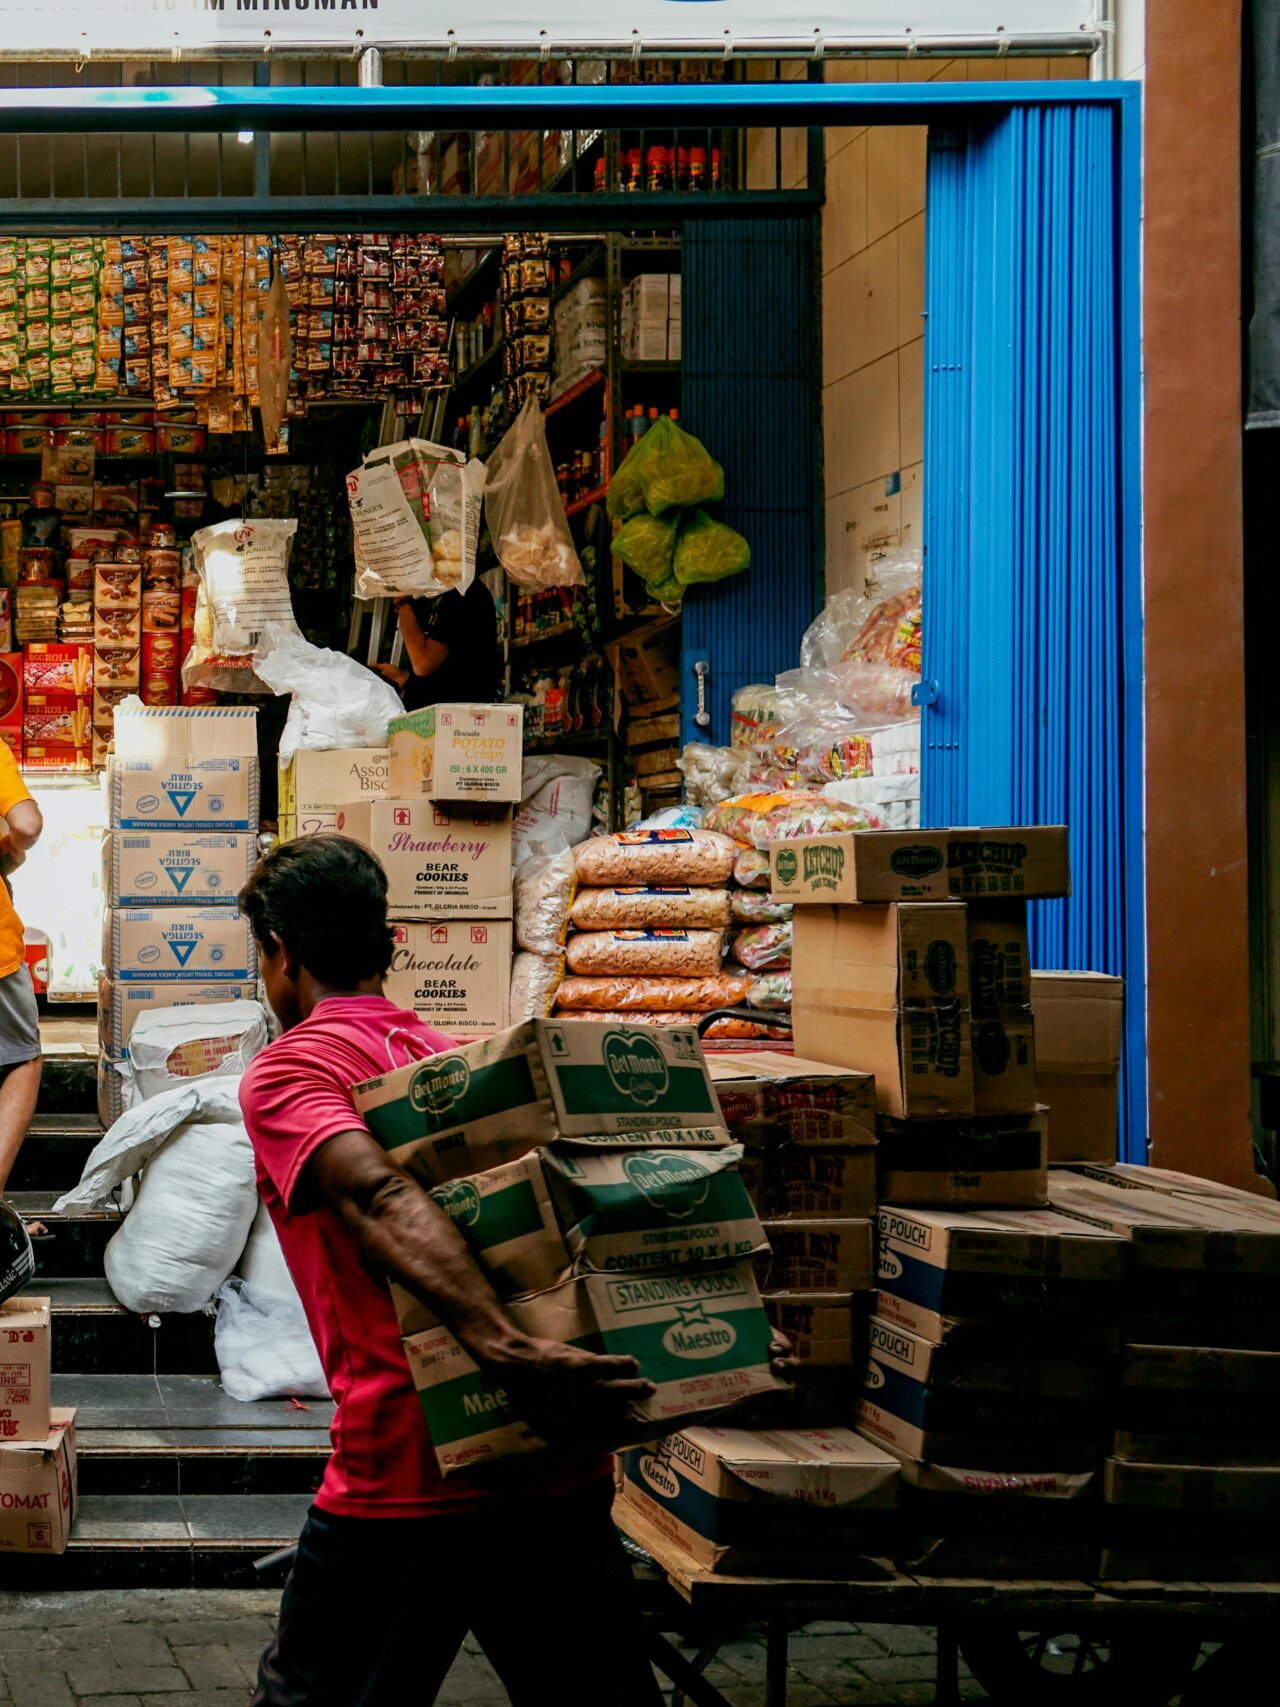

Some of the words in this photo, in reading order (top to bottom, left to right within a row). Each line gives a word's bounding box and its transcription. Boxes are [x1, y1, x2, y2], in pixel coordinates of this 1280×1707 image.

[357, 504, 384, 516] FUNGUS
[29, 654, 45, 662] EGG
[45, 653, 69, 662] ROLL
[28, 706, 44, 714] EGG
[44, 705, 69, 714] ROLL
[452, 729, 480, 737] Biscuits
[451, 737, 506, 749] POTATO
[27, 757, 43, 765] EGG
[464, 750, 506, 761] Crispy
[449, 765, 460, 773] ISI
[495, 766, 507, 774] GR
[171, 774, 193, 782] BIRU
[161, 782, 204, 790] SEGITIGA
[387, 831, 490, 861] Strawberry
[911, 855, 940, 864] Monte
[947, 841, 1028, 869] KETCHUP
[426, 863, 459, 872] BEAR
[802, 844, 845, 882] KETCHUP
[415, 872, 469, 882] COOKIES
[171, 923, 194, 931] BIRU
[161, 931, 204, 940] SEGITIGA
[390, 949, 482, 973] Chocolate
[424, 979, 457, 988] BEAR
[414, 989, 467, 998] COOKIES
[609, 1053, 629, 1074] Del
[630, 1053, 666, 1075] Monte
[413, 1081, 431, 1100] Del
[431, 1068, 466, 1093] Monte
[616, 1116, 655, 1128] STANDING
[656, 1115, 682, 1127] POUCH
[587, 1131, 651, 1144] CONTENT
[654, 1130, 673, 1143] 10
[675, 1131, 686, 1142] X
[688, 1130, 695, 1142] 1
[696, 1129, 716, 1141] KG
[633, 1171, 655, 1190] Del
[657, 1165, 705, 1187] Monte
[642, 1232, 686, 1245] STANDING
[686, 1228, 720, 1240] POUCH
[890, 1219, 928, 1247] POUCH
[603, 1248, 681, 1270] CONTENT
[686, 1246, 705, 1262] 10
[707, 1245, 719, 1261] X
[722, 1244, 730, 1259] 1
[733, 1239, 753, 1254] KG
[617, 1274, 687, 1307] STANDING
[689, 1267, 740, 1296] POUCH
[670, 1322, 730, 1354] Maestro
[872, 1327, 910, 1359] POUCH
[672, 1435, 703, 1470] POUCH
[641, 1458, 677, 1495] Maestro
[35, 1529, 44, 1541] 6
